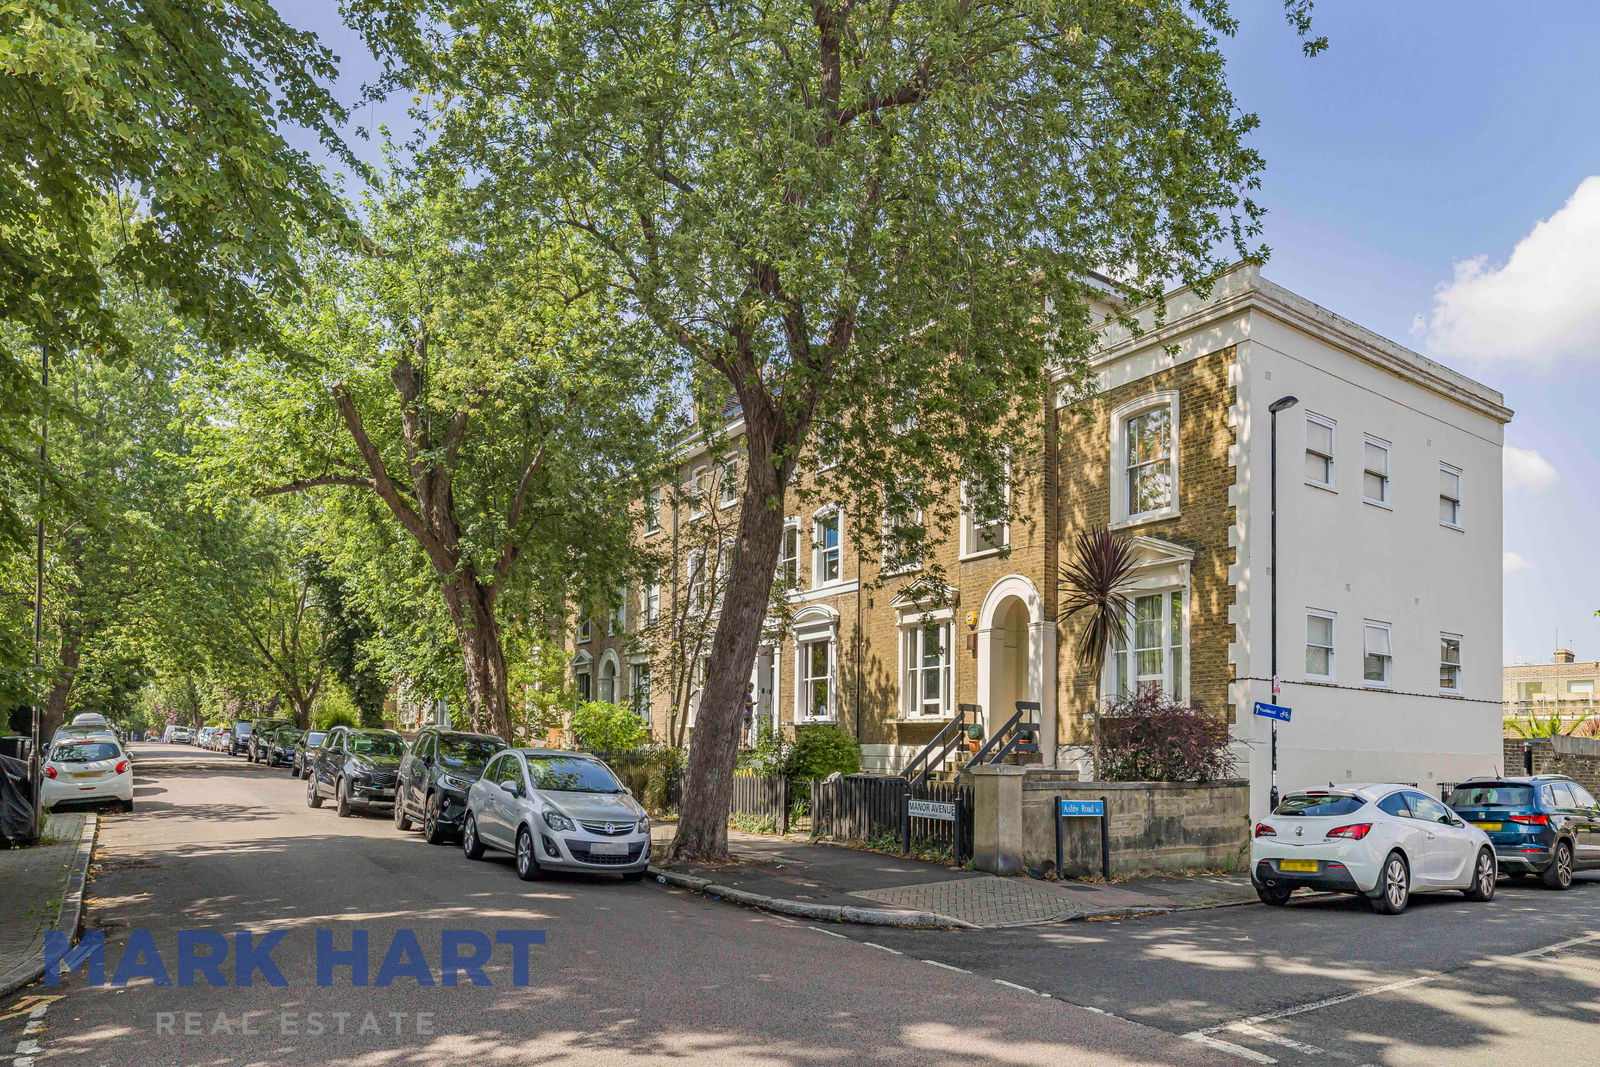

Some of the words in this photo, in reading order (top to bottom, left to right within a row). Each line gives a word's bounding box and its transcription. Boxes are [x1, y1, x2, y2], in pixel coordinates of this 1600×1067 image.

[910, 801, 930, 812] MANOR
[931, 804, 956, 816] AVENUE
[1063, 804, 1079, 815] Ashby
[1081, 804, 1094, 813] Road
